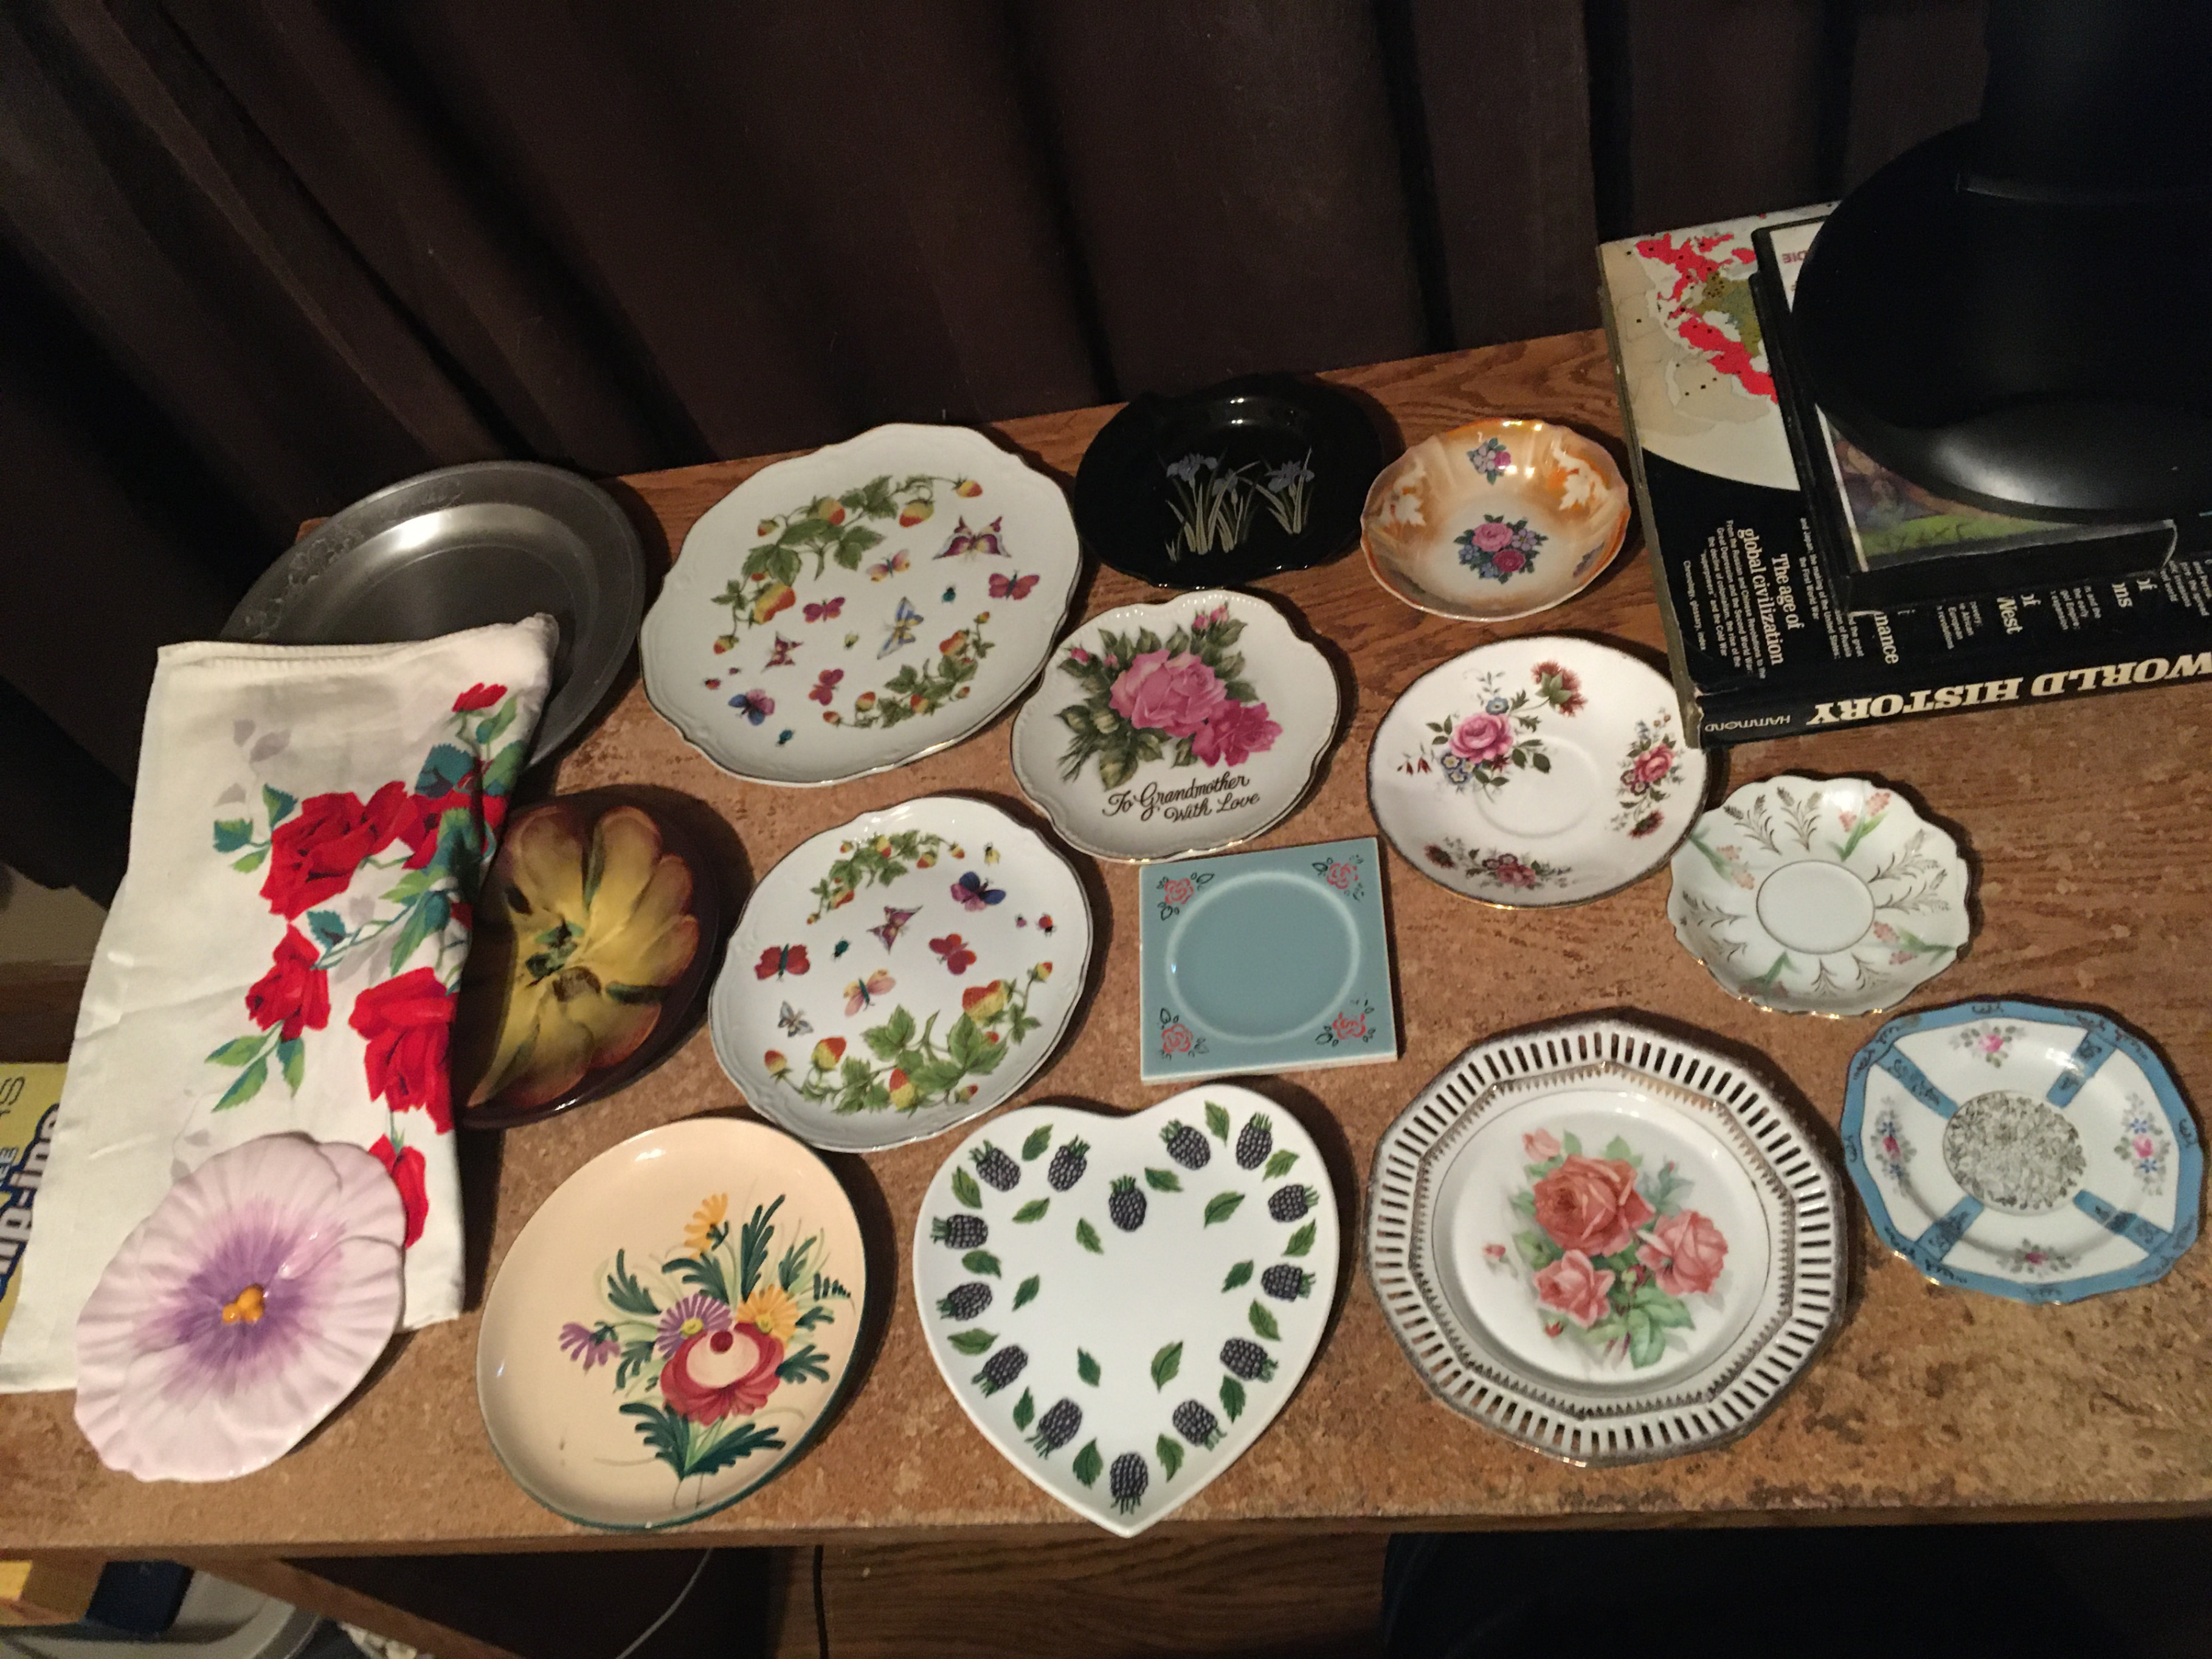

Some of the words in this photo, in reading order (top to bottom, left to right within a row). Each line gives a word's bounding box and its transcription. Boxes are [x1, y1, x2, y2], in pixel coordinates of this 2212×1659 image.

[1716, 527, 1727, 547] Great
[1726, 519, 1735, 538] From
[1720, 546, 1733, 584] Depression
[1732, 549, 1743, 576] Russian
[1771, 553, 1791, 584] The
[1728, 584, 1738, 597] and
[1738, 577, 1748, 589] and
[1806, 584, 1817, 605] World
[1710, 548, 1720, 572] decline
[1728, 632, 1737, 647] rise
[1710, 599, 1719, 613] and
[1731, 597, 1740, 609] the
[1737, 528, 1767, 574] global
[1752, 575, 1784, 666] civilization
[1741, 589, 1752, 617] Chinese
[1776, 585, 1796, 612] age
[1812, 566, 1823, 591] making
[1823, 611, 1836, 634] United
[1733, 609, 1747, 634] Second
[1785, 614, 1805, 630] of
[1811, 605, 1819, 620] War
[1697, 631, 1706, 651] index
[1715, 625, 1726, 642] Cold
[1740, 635, 1751, 656] World
[1747, 617, 1761, 659] Revolutions
[1840, 634, 1852, 657] Russia
[1874, 615, 1899, 664] nance
[1719, 642, 1728, 657] War
[2031, 651, 2212, 697] WORLD
[1806, 677, 2024, 726] HISTORY
[1704, 715, 1791, 732] HAMMOND
[1102, 790, 1134, 817] To
[1133, 770, 1250, 822] Grandmother
[1164, 797, 1212, 822] With
[1216, 792, 1260, 813] Love
